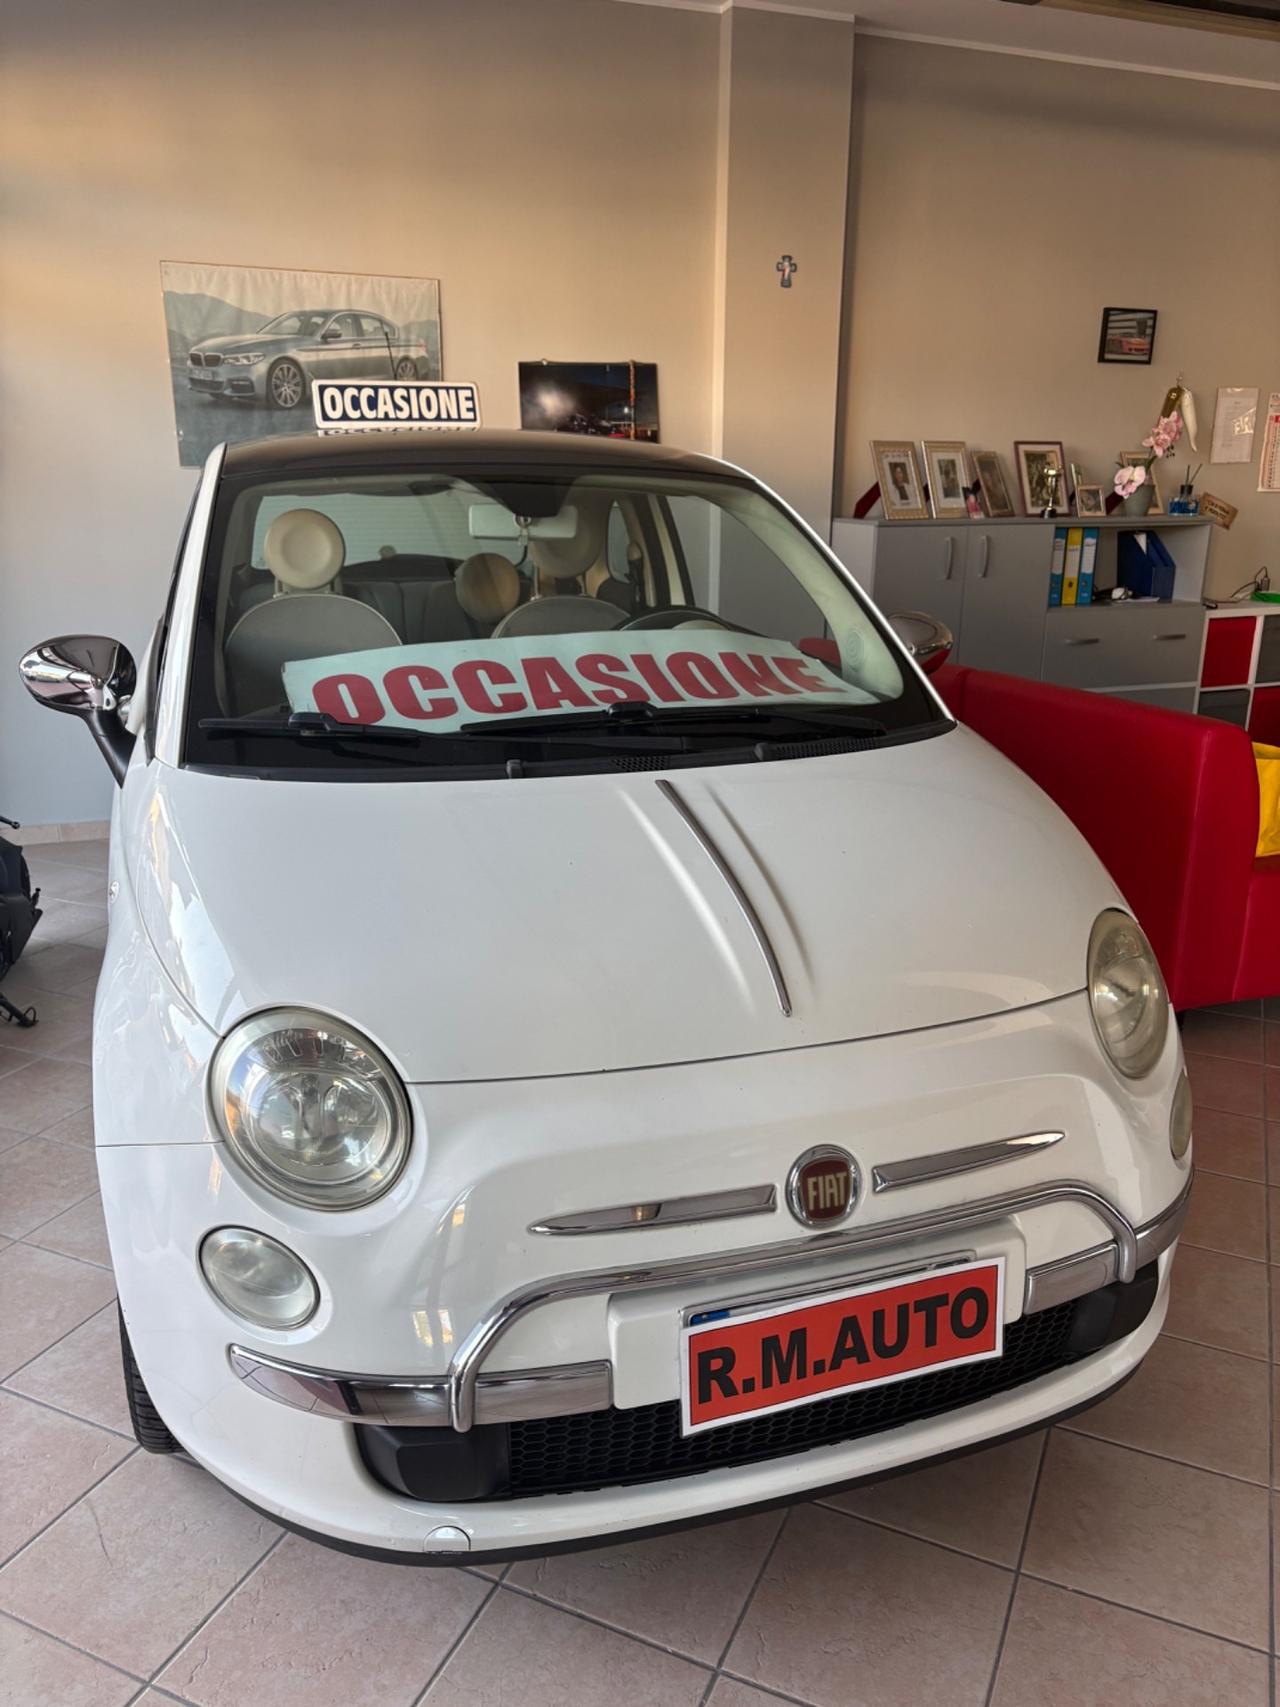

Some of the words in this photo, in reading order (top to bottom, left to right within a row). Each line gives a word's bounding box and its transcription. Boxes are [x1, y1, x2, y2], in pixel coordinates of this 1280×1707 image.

[323, 387, 475, 420] OCCASIONE
[311, 652, 843, 726] OCCASIONE
[808, 1172, 848, 1210] FIAT
[697, 1286, 989, 1405] R.M.AUTO
